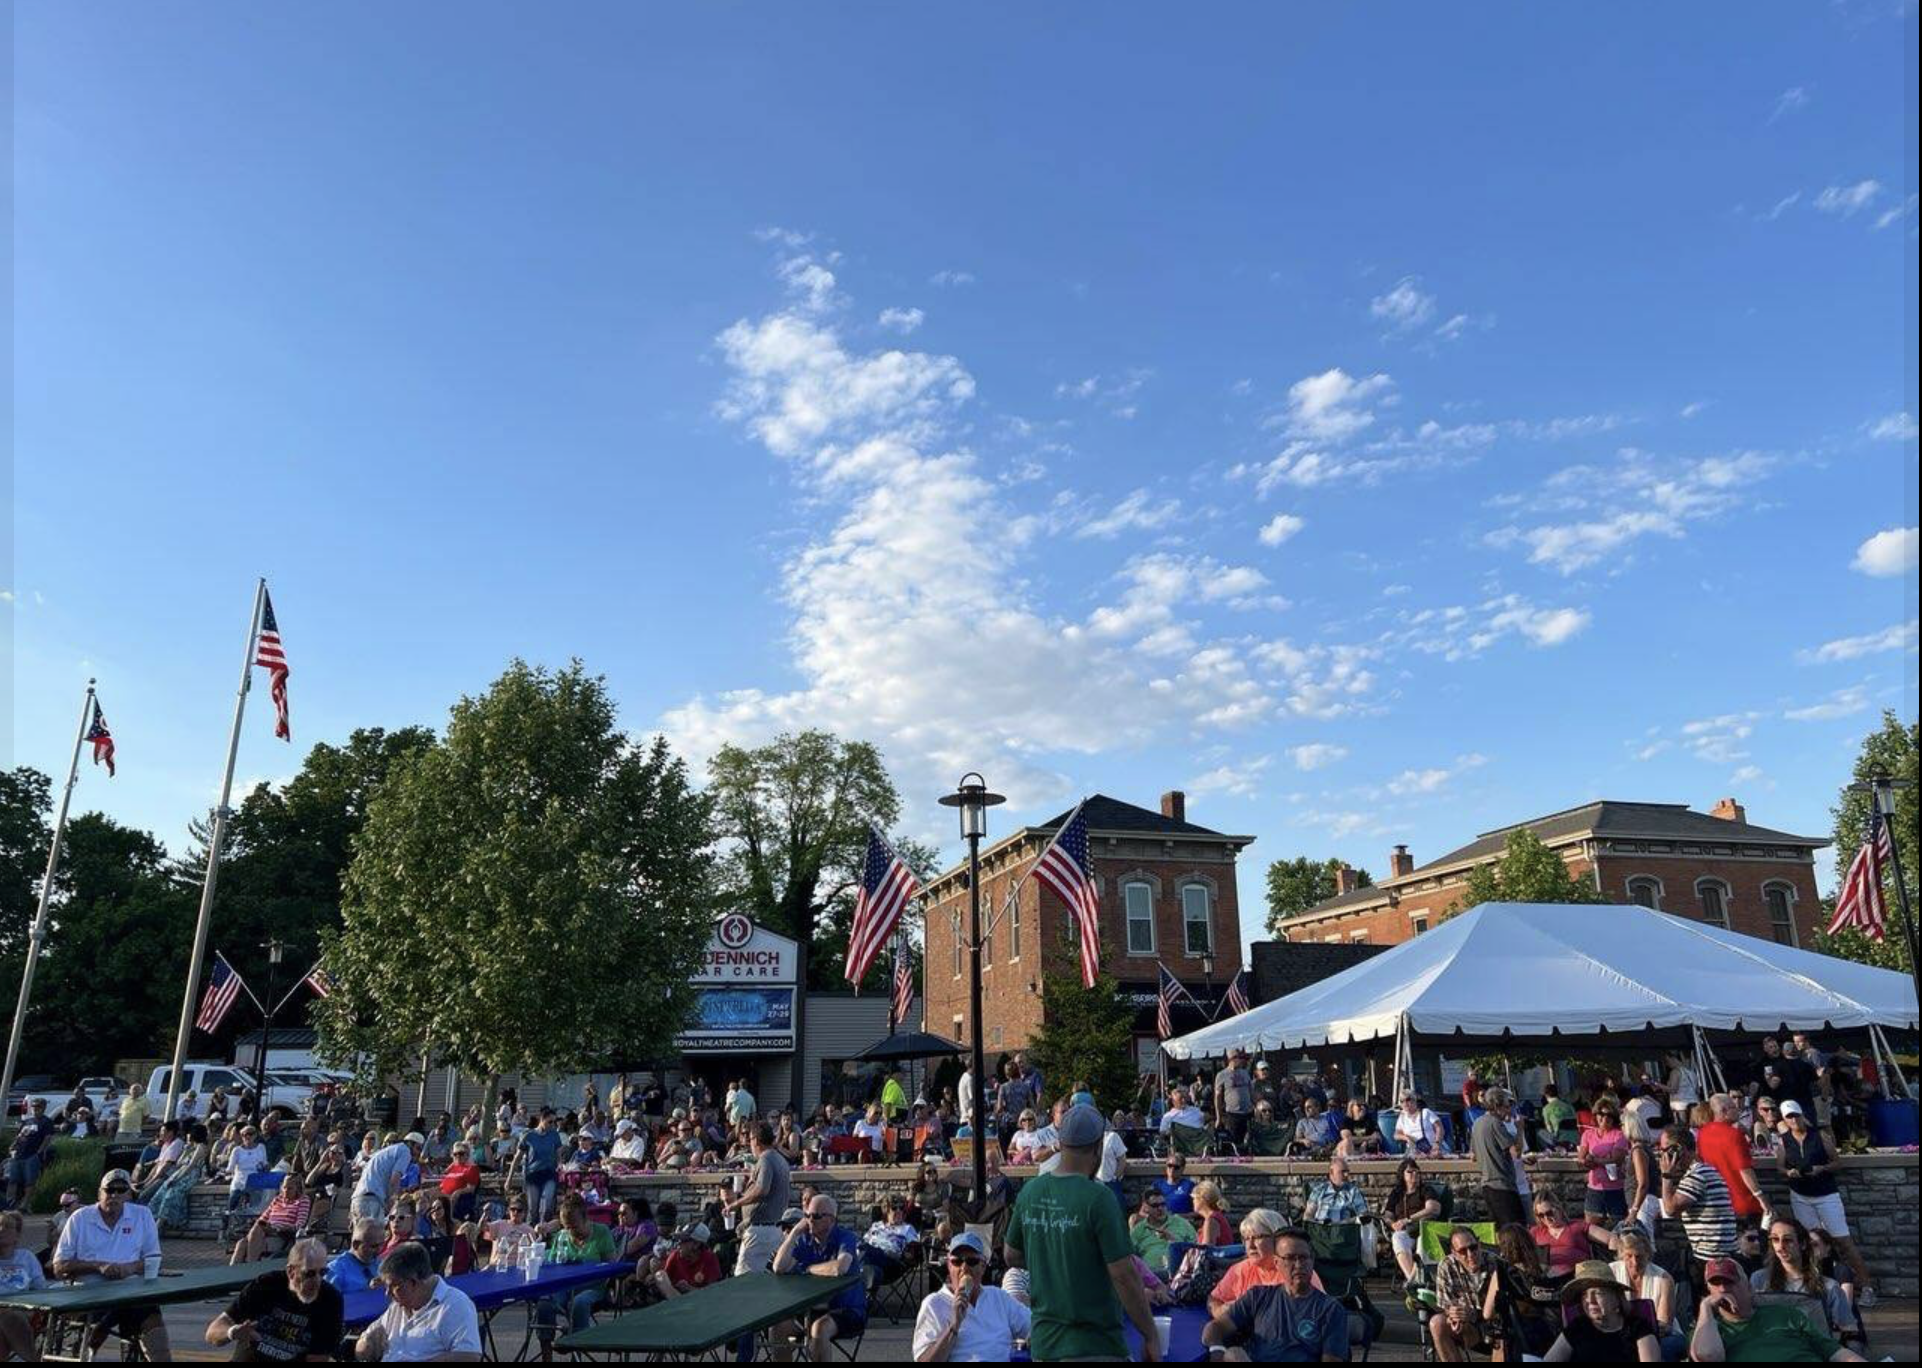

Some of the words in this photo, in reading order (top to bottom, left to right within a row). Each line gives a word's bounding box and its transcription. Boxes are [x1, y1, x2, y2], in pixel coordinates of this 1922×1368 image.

[701, 951, 779, 965] UENNICH
[700, 967, 722, 976] AR
[733, 967, 780, 977] CARE
